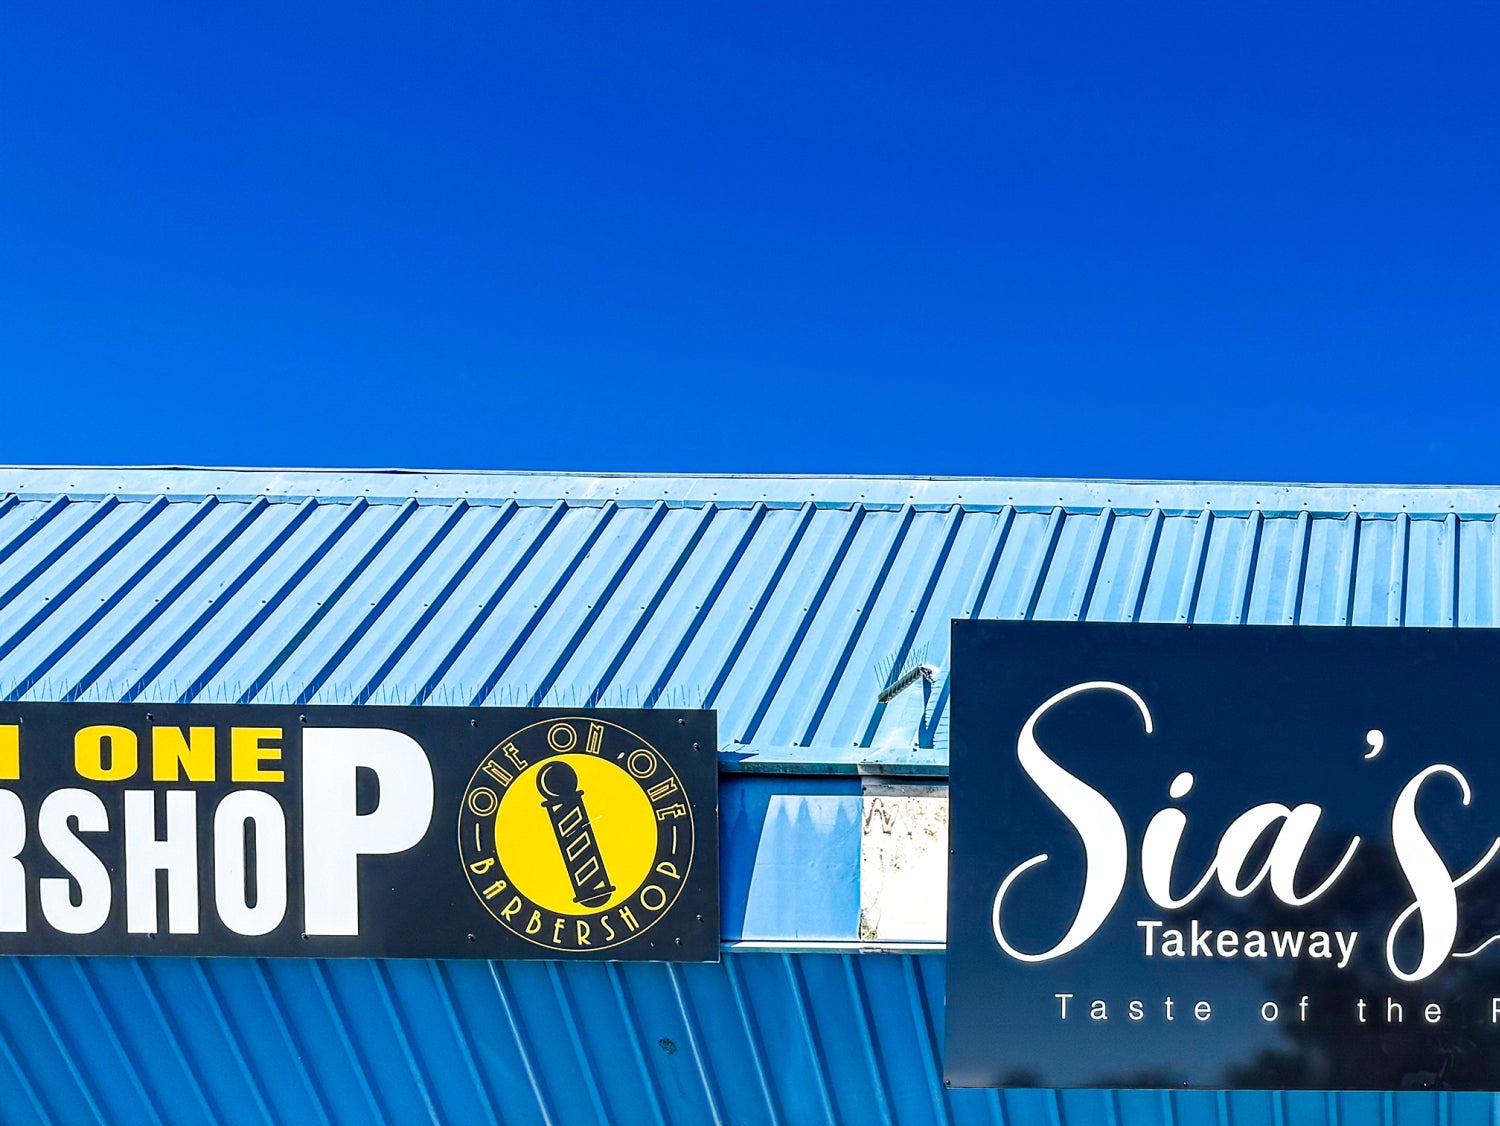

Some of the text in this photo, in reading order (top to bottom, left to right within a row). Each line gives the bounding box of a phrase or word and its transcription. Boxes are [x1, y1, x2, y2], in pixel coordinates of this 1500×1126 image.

[74, 725, 285, 782] ONE
[468, 722, 687, 821] ONE ON ONE
[470, 857, 681, 946] BARBERSHOP
[1137, 920, 1358, 967] Takeaway
[1055, 994, 1211, 1022] Taste
[1261, 998, 1310, 1022] of
[1358, 998, 1442, 1023] the
